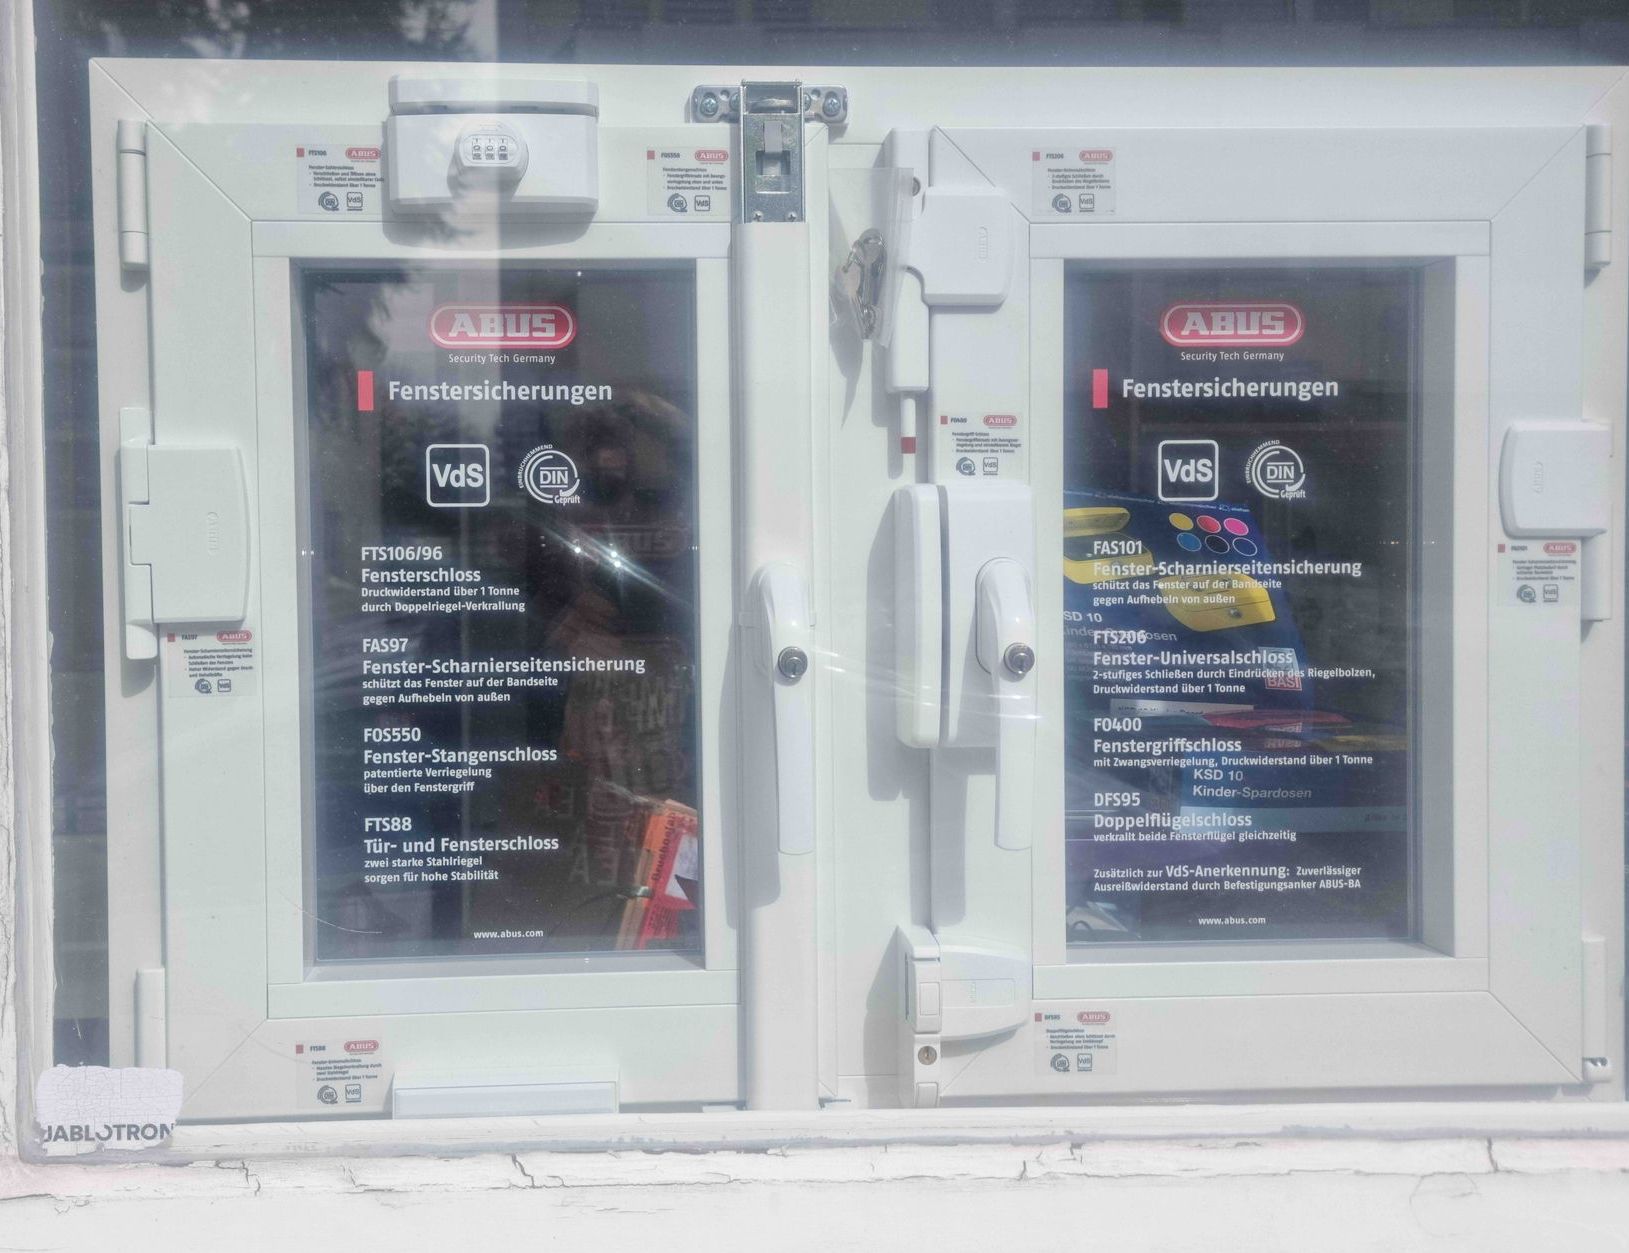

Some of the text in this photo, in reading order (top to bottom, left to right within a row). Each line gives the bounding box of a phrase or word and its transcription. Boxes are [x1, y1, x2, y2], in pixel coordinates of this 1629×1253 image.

[449, 314, 555, 337] ABUS
[1181, 311, 1284, 335] ABUS
[449, 353, 555, 365] Security Tech Germany
[1181, 351, 1284, 362] Security Tech Germany
[389, 380, 612, 406] Fenstersicherungen
[1123, 377, 1338, 401] Fenstersicherungen
[433, 463, 483, 488] VdS
[1164, 458, 1213, 483] VdS
[1267, 466, 1294, 479] DIN
[540, 471, 568, 484] DIN
[555, 495, 580, 505] Geprüft
[1280, 490, 1306, 500] Geprüft
[362, 546, 442, 562] FTS106/96
[1094, 540, 1142, 555] FAS101
[1094, 560, 1362, 576] Fenster-Scharnierseitensicherung
[362, 568, 481, 582] Fensterschloss
[1093, 579, 1282, 590] schützt das Fenster auf der Bandseite
[362, 586, 519, 597] Druckwiderstand über 1 Tonne
[362, 600, 525, 613] durch Doppelriegel-Verkrallung
[1093, 594, 1235, 606] gegen Aufhebeln von außen
[1064, 611, 1102, 622] SD 10
[1094, 630, 1146, 644] FTS206
[363, 638, 408, 653] FAS97
[1094, 648, 1294, 666] Fenster-Universalschloss
[363, 657, 645, 674] Fenster-Scharnierseitensicherung
[1093, 667, 1375, 680] 2-stufiges Schließen durch Eindrücken des Riegelbolzen,
[363, 676, 558, 689] schützt das Fenster auf der Bandseite
[1094, 683, 1245, 694] Druckwiderstand über 1 Tonne
[1268, 678, 1299, 688] BASI
[363, 692, 510, 705] gegen Aufhebeln von außen
[1094, 738, 1242, 755] Fenstergriffschloss
[364, 747, 557, 765] Fenster-Stangenschloss
[1094, 754, 1373, 768] mit Zwangsverriegelung, Druckwiderstand über 1 Tonne
[364, 766, 492, 779] patentierte Verriegelung
[1193, 768, 1243, 781] KSD 10
[364, 781, 475, 794] über den Fenstergriff
[1193, 786, 1311, 800] Kinder-Spardosen
[1094, 793, 1140, 806] DFS95
[365, 817, 412, 832] FTS88
[1094, 812, 1251, 830] Doppelflügelschloss
[1094, 829, 1297, 842] verkrallt beide Fensterflügel gleichzeitig
[365, 835, 559, 854] Tür- und Fensterschloss
[365, 856, 482, 868] zwei starke Stahlriegel
[365, 869, 499, 884] sorgen für hohe Stabilität
[1094, 865, 1361, 879] Zusätzlich zur VdS-Anerkennung: Zuverlässiger
[1094, 879, 1361, 892] Ausreißwiderstand durch Befestigungsanker ABUS-BA
[1198, 915, 1266, 925] www.abus.com
[474, 929, 543, 939] www.abus.com
